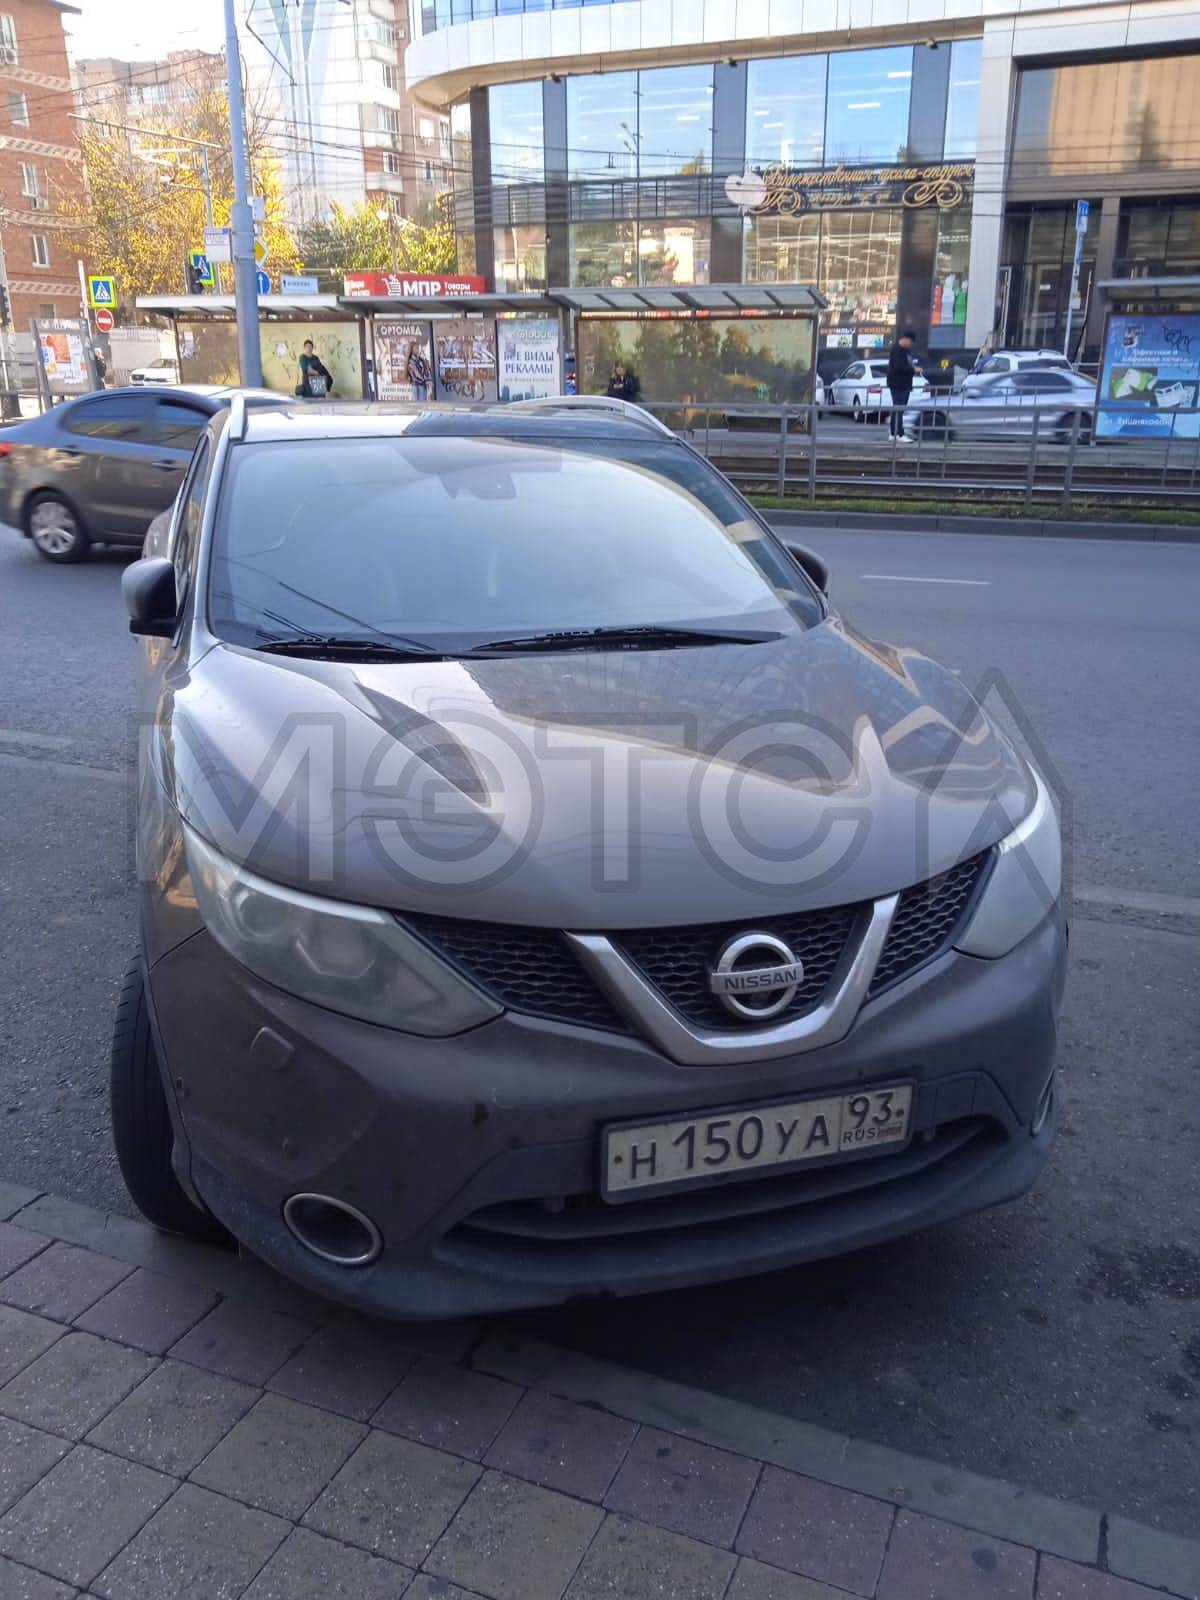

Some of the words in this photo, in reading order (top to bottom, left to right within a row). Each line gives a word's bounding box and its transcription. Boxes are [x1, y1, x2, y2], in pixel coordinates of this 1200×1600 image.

[402, 281, 441, 297] МПР
[380, 326, 422, 336] ОРТОМЕД
[525, 351, 554, 361] ВИДЫ
[505, 363, 553, 374] РЕКЛАМЫ
[724, 970, 798, 991] NISSAN
[849, 1092, 894, 1128] 93
[843, 1127, 876, 1144] RUS
